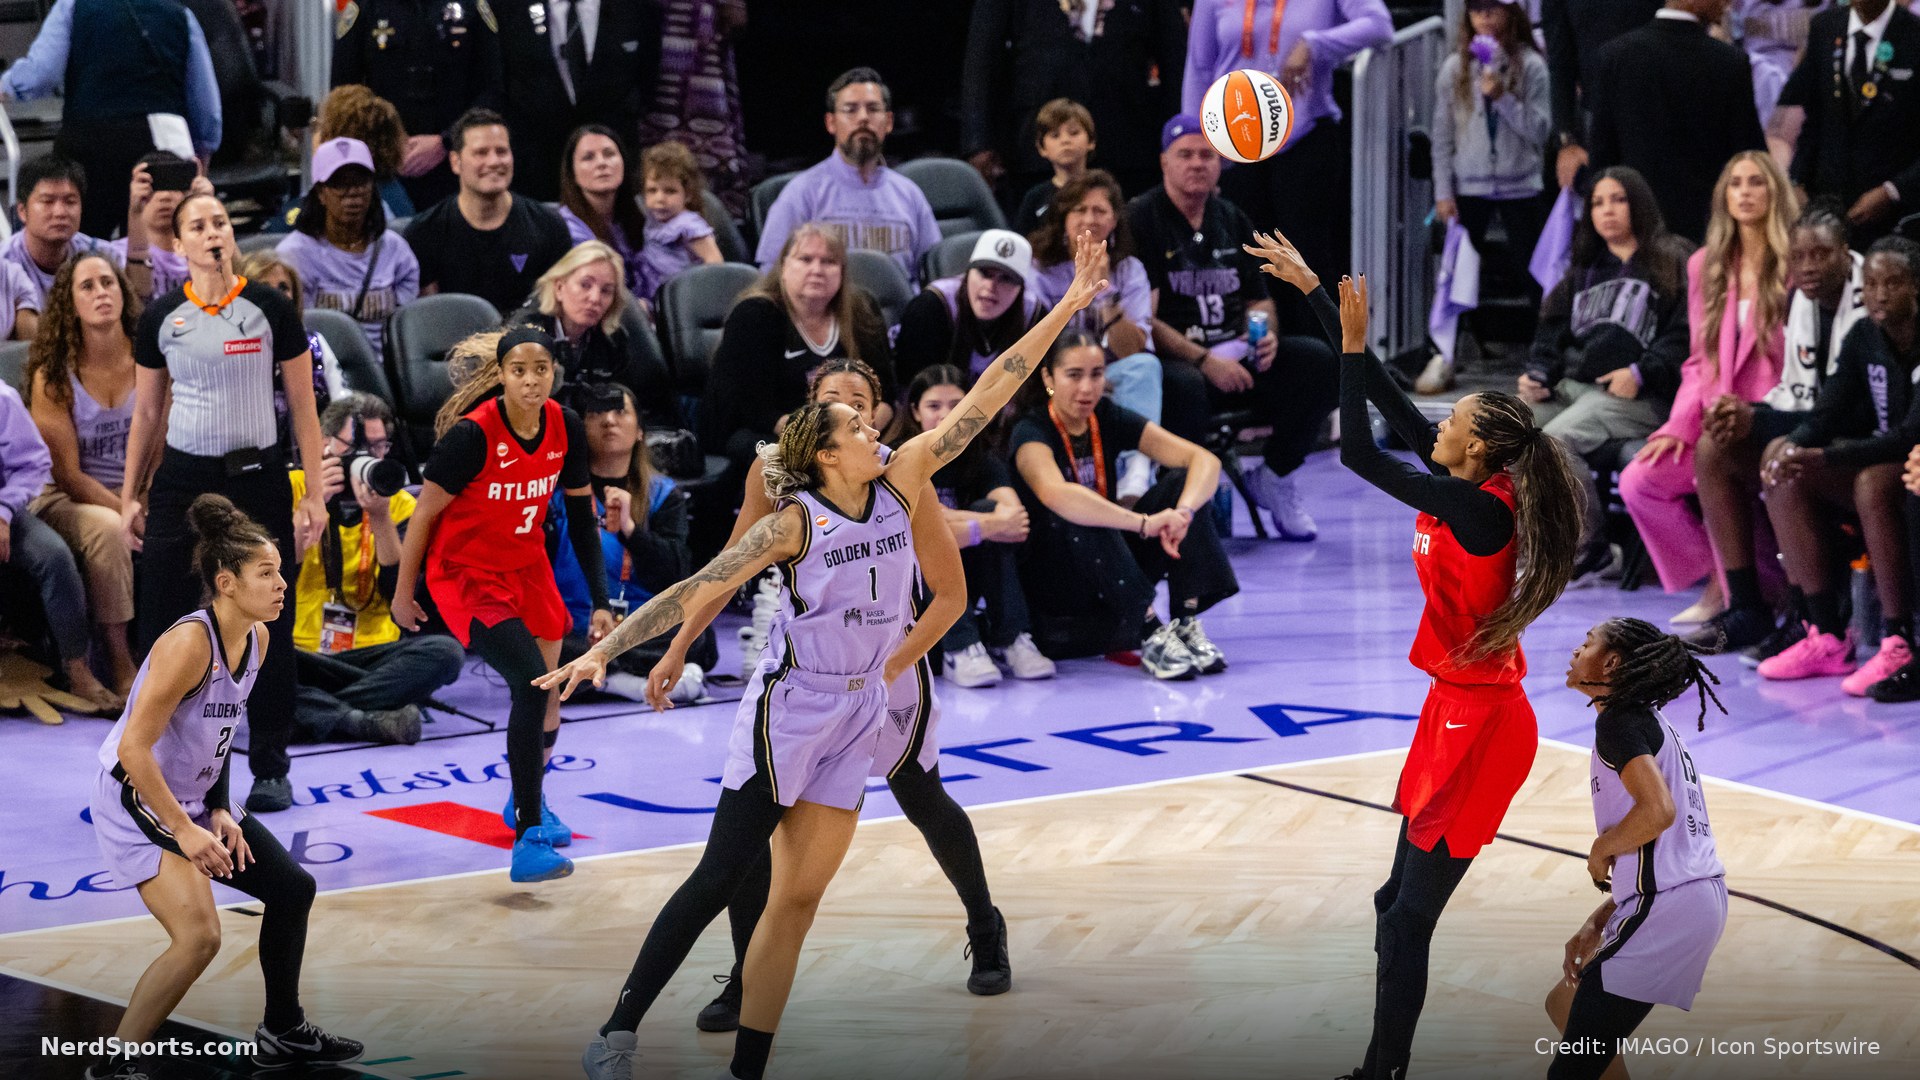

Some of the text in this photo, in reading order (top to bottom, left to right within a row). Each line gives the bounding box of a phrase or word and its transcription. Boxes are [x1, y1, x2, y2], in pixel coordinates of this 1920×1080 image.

[1260, 81, 1282, 143] Wilson
[1196, 294, 1225, 326] 13
[225, 340, 262, 353] Emirates
[515, 505, 539, 534] 3
[823, 531, 908, 569] GOLDEN STATE
[868, 565, 878, 602] 1
[203, 702, 239, 719] GOLDEN
